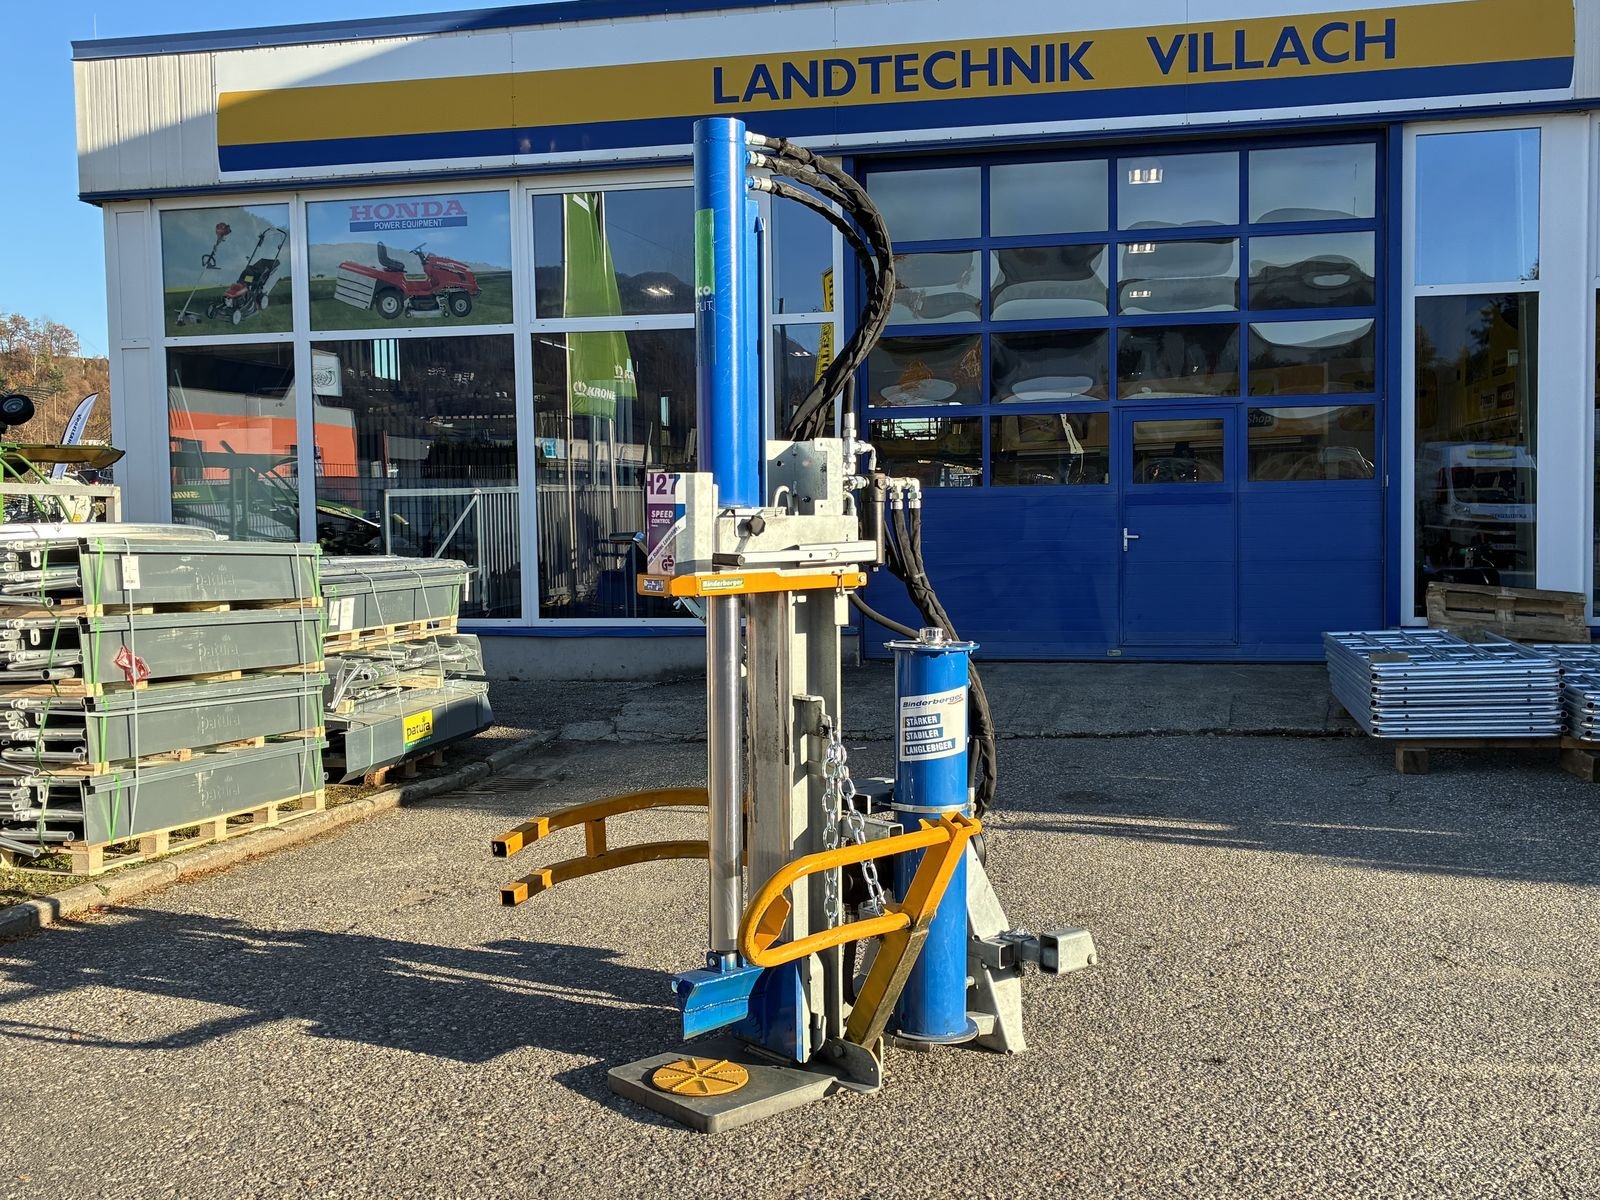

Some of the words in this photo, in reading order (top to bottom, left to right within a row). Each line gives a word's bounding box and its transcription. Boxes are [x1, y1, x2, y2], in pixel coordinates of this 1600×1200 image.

[713, 40, 1094, 104] LANDTECHNIK
[1146, 18, 1396, 75] VILLACH
[349, 199, 468, 221] HONDA
[374, 222, 400, 230] POWER
[402, 218, 443, 229] EQUIPMENT
[695, 285, 711, 297] CO
[651, 510, 674, 518] SPEED
[903, 694, 962, 708] Binderberger
[407, 721, 430, 741] patura
[906, 729, 939, 740] STABILER
[906, 740, 953, 755] LANGLEBIGER
